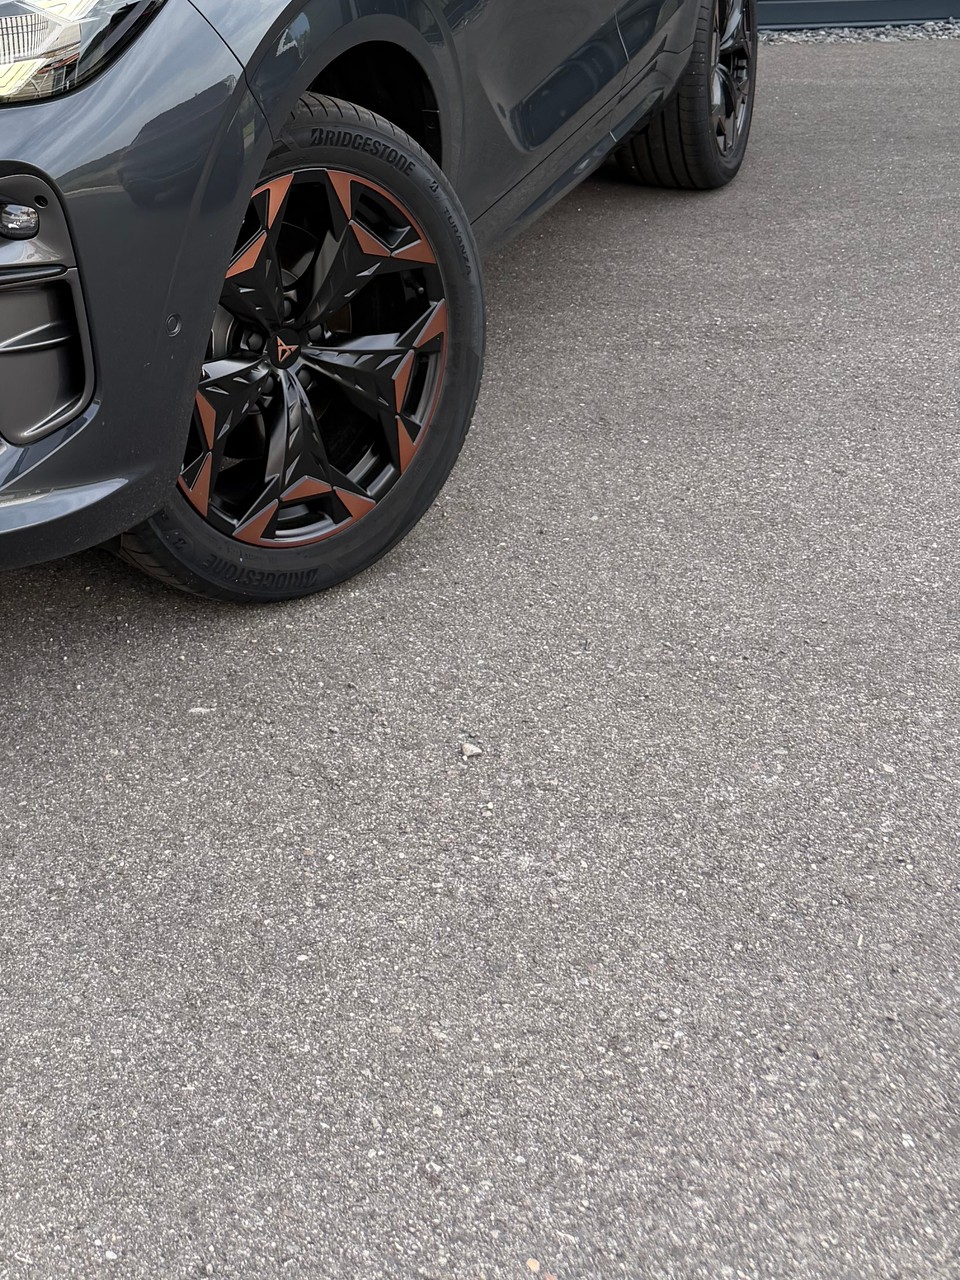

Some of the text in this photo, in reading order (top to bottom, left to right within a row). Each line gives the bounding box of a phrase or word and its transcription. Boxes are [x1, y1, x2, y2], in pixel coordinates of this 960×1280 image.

[310, 127, 416, 177] BRIDGESTONE
[443, 206, 472, 276] TURANZA
[201, 552, 319, 589] BRIDGESTONE
